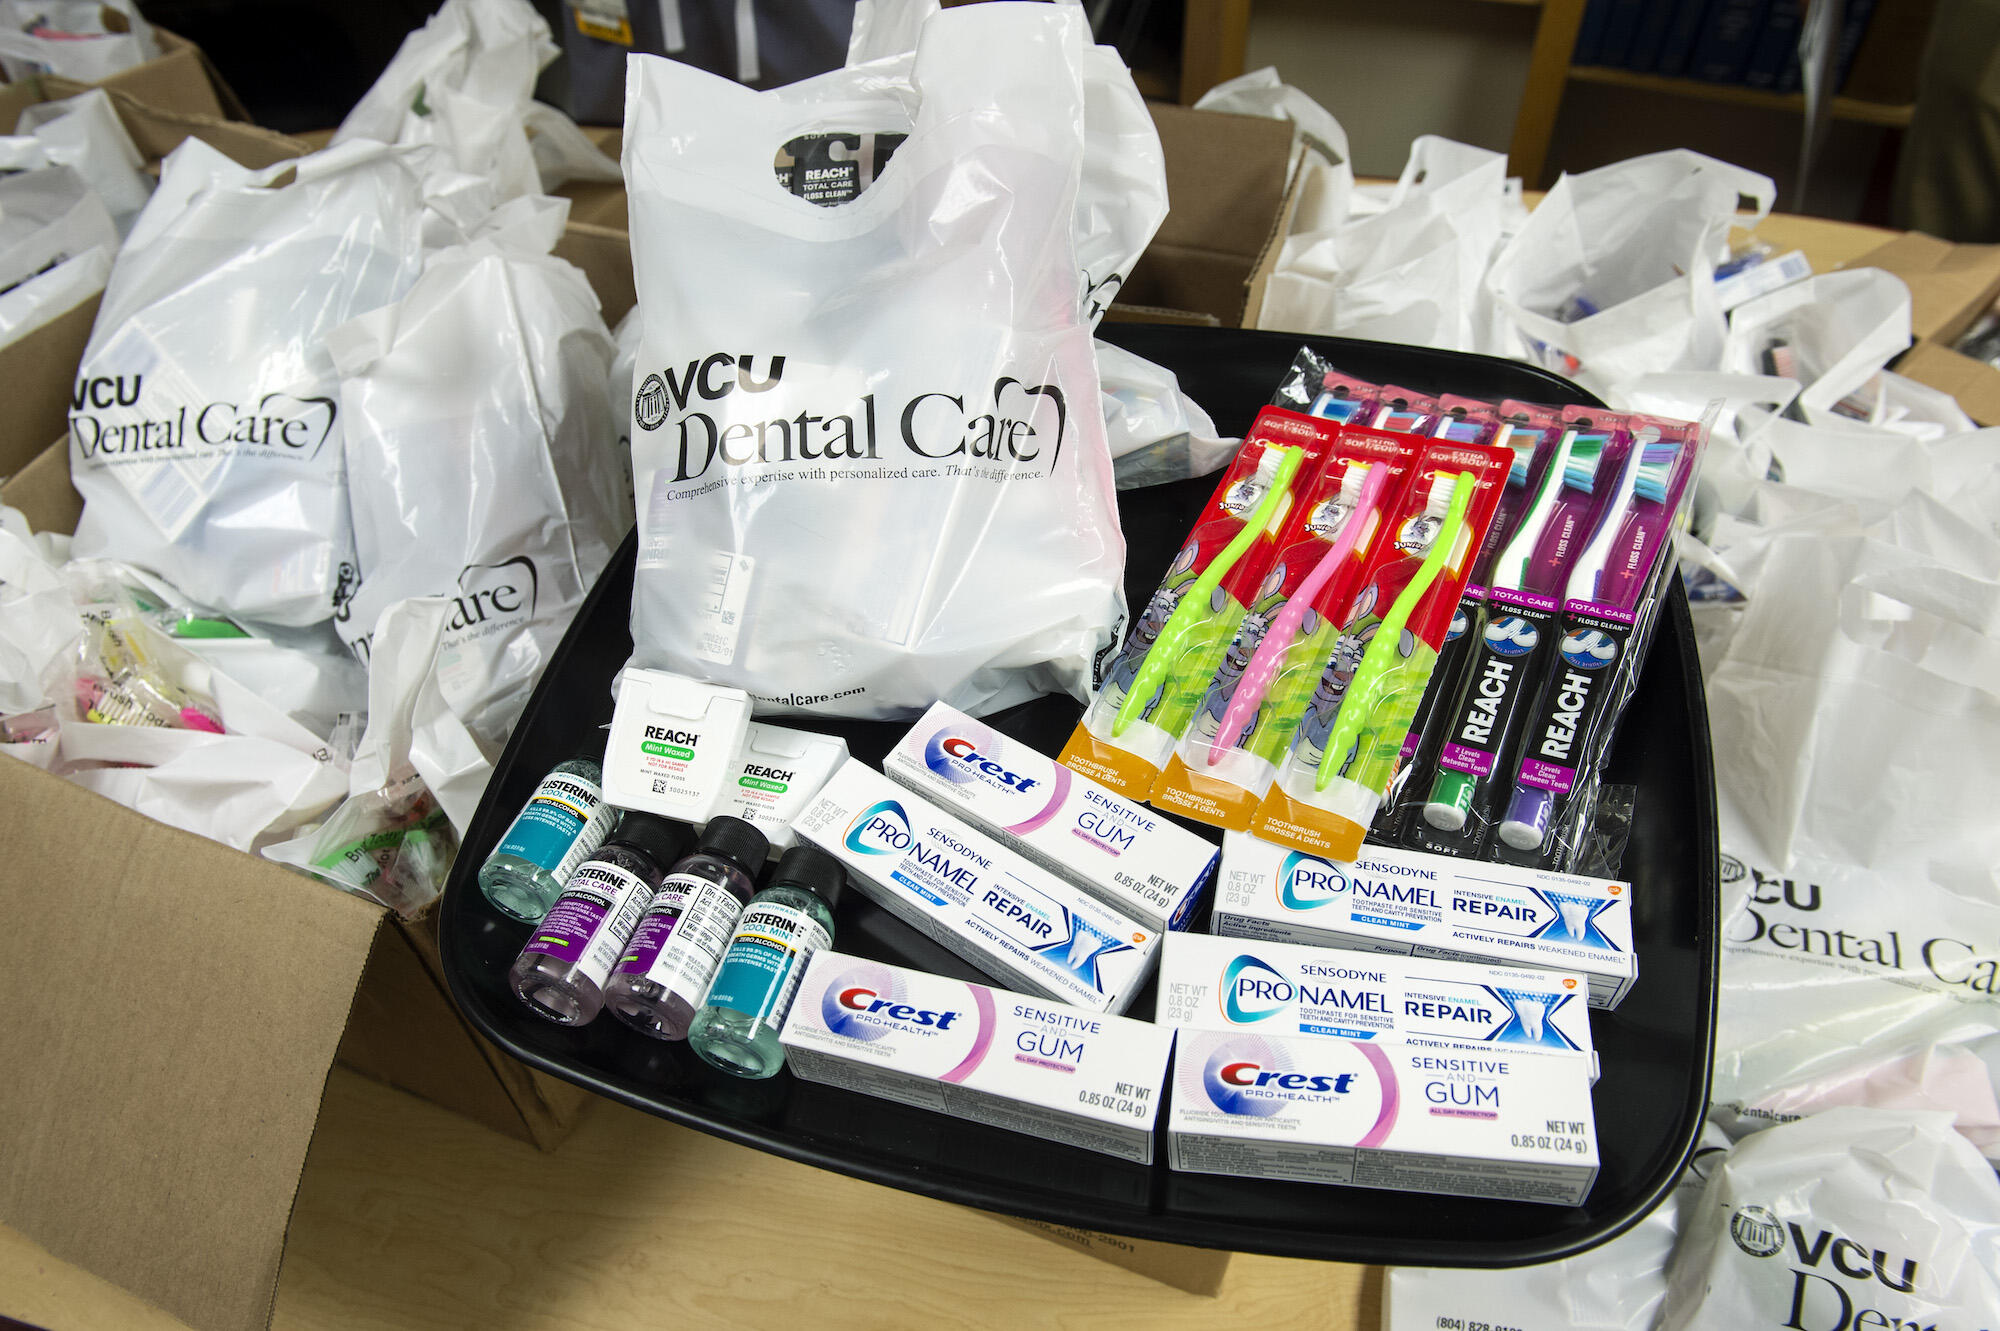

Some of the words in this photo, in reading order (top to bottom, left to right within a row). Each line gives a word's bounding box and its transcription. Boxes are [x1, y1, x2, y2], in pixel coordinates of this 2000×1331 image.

[805, 167, 849, 181] REACH
[803, 182, 829, 191] TOTAL
[831, 180, 853, 189] CARE
[664, 352, 786, 411] VCU
[70, 407, 186, 459] Dental
[197, 402, 308, 448] Care
[670, 394, 883, 483] Dental
[900, 393, 1040, 463] Care
[667, 475, 737, 501] Comprehensive
[741, 470, 794, 487] expertise
[799, 468, 826, 480] with
[830, 467, 908, 482] personalized
[1562, 519, 1575, 539] CLEAN
[1556, 537, 1570, 558] FLOSS
[1633, 530, 1646, 551] CLEAN
[1627, 549, 1640, 570] FLOSS
[428, 585, 521, 632] are
[1494, 590, 1524, 602] TOTAL
[1527, 598, 1554, 608] CARE
[1501, 605, 1522, 615] FLOSS
[1523, 610, 1545, 619] CLEAN
[1569, 602, 1601, 614] TOTAL
[1604, 609, 1633, 621] CARE
[1577, 617, 1599, 627] FLOSS
[1600, 622, 1623, 631] CLEAN
[1461, 658, 1513, 745] REACH
[1540, 672, 1592, 760] REACH
[645, 725, 698, 747] REACH
[645, 744, 663, 753] Mint
[664, 746, 691, 758] Waxed
[1458, 754, 1476, 763] Clean
[1461, 748, 1481, 759] Levels
[744, 764, 793, 782] REACH
[943, 738, 1038, 793] Crest
[1066, 761, 1095, 776] BROSSE
[1102, 773, 1127, 787] DENTS
[1070, 754, 1119, 777] TOOTHBRUSH
[1442, 756, 1469, 769] Between
[1470, 764, 1488, 774] Teeth
[1538, 770, 1556, 780] Clean
[1540, 764, 1561, 775] Levels
[1521, 772, 1549, 785] Between
[1549, 780, 1569, 790] Teeth
[541, 789, 564, 799] COOL
[565, 795, 589, 810] MINT
[542, 780, 600, 808] LISTERINE
[1166, 786, 1217, 807] TOOTHBRUSH
[552, 801, 579, 818] ALCOHOL
[1084, 790, 1156, 832] SENSITIVE
[1162, 793, 1193, 808] BROSSE
[1200, 805, 1226, 818] DENTS
[1102, 812, 1125, 827] AND
[1267, 816, 1321, 838] TOOTHBRUSH
[1078, 812, 1135, 850] GUM
[1264, 824, 1296, 839] BROSSE
[1303, 835, 1331, 849] DENTS
[927, 827, 992, 870] SENSODYNE
[1425, 843, 1459, 856] SOFT
[903, 859, 935, 879] TOOTHPASTE
[935, 877, 945, 886] FOR
[945, 885, 970, 902] SENSITIVE
[1229, 870, 1249, 881] NET
[1249, 873, 1265, 884] WT
[1355, 860, 1437, 881] SENSODYNE
[591, 880, 617, 896] CARE
[899, 876, 919, 891] CLEAN
[920, 888, 937, 901] MINT
[1114, 871, 1133, 888] 0.85
[1132, 881, 1146, 895] OZ
[1143, 887, 1160, 902] (24
[1147, 874, 1165, 888] NET
[1164, 882, 1180, 897] WT
[1227, 880, 1242, 892] 0.8
[1243, 883, 1257, 894] OZ
[575, 893, 605, 907] ALCOHOL
[661, 893, 685, 902] CARE
[993, 883, 1025, 905] INTENSIVE
[1025, 902, 1051, 921] ENAMEL
[1352, 899, 1392, 910] TOOTHPASTE
[1395, 904, 1408, 912] FOR
[1410, 906, 1442, 917] SENSITIVE
[1453, 890, 1494, 900] INTENSIVE
[1495, 895, 1527, 906] ENAMEL
[983, 890, 1053, 939] REPAIR
[1453, 898, 1537, 923] REPAIR
[742, 912, 805, 938] LISTERINE
[743, 924, 766, 932] COOL
[768, 927, 793, 942] MINT
[1361, 916, 1387, 925] CLEAN
[1389, 919, 1410, 929] MINT
[754, 938, 786, 953] ALCOHOL
[1452, 931, 1494, 943] ACTIVELY
[1497, 938, 1535, 950] REPAIRS
[1537, 944, 1586, 958] WEAKENED
[1588, 953, 1623, 964] ENAMEL
[965, 919, 999, 942] ACTIVELY
[999, 939, 1030, 961] REPAIRS
[1030, 958, 1069, 986] WEAKENED
[1068, 981, 1099, 1005] ENAMEL
[1922, 938, 2000, 995] Ca
[1301, 964, 1387, 983] SENSODYNE
[1170, 983, 1191, 994] NET
[1192, 985, 1208, 996] WT
[1405, 992, 1446, 1002] INTENSIVE
[1447, 996, 1482, 1006] ENAMEL
[839, 988, 957, 1030] Crest
[1168, 995, 1184, 1006] 0.8
[1185, 997, 1199, 1008] OZ
[1013, 1005, 1101, 1034] SENSITIVE
[1300, 1008, 1343, 1018] TOOTHPASTE
[1360, 1014, 1394, 1023] SENSITIVE
[1405, 1001, 1492, 1024] REPAIR
[1040, 1025, 1067, 1038] AND
[1310, 1027, 1337, 1036] CLEAN
[1340, 1029, 1362, 1038] MINT
[1016, 1030, 1084, 1064] GUM
[1406, 1038, 1450, 1049] ACTIVELY
[1412, 1056, 1510, 1075] SENSITIVE
[1221, 1063, 1353, 1094] Crest
[1446, 1073, 1476, 1083] AND
[1115, 1082, 1134, 1096] NET
[1135, 1086, 1151, 1100] WT
[1425, 1081, 1500, 1108] GUM
[1079, 1090, 1101, 1106] 0.85
[1102, 1095, 1116, 1109] OZ
[1116, 1098, 1134, 1114] (24
[1546, 1120, 1566, 1134] NET
[1568, 1123, 1585, 1135] WT
[1511, 1135, 1535, 1149] 0.85
[1537, 1137, 1551, 1150] OZ
[1554, 1138, 1572, 1152] (24
[1787, 1221, 1918, 1293] VCU
[1781, 1268, 1938, 1331] Den
